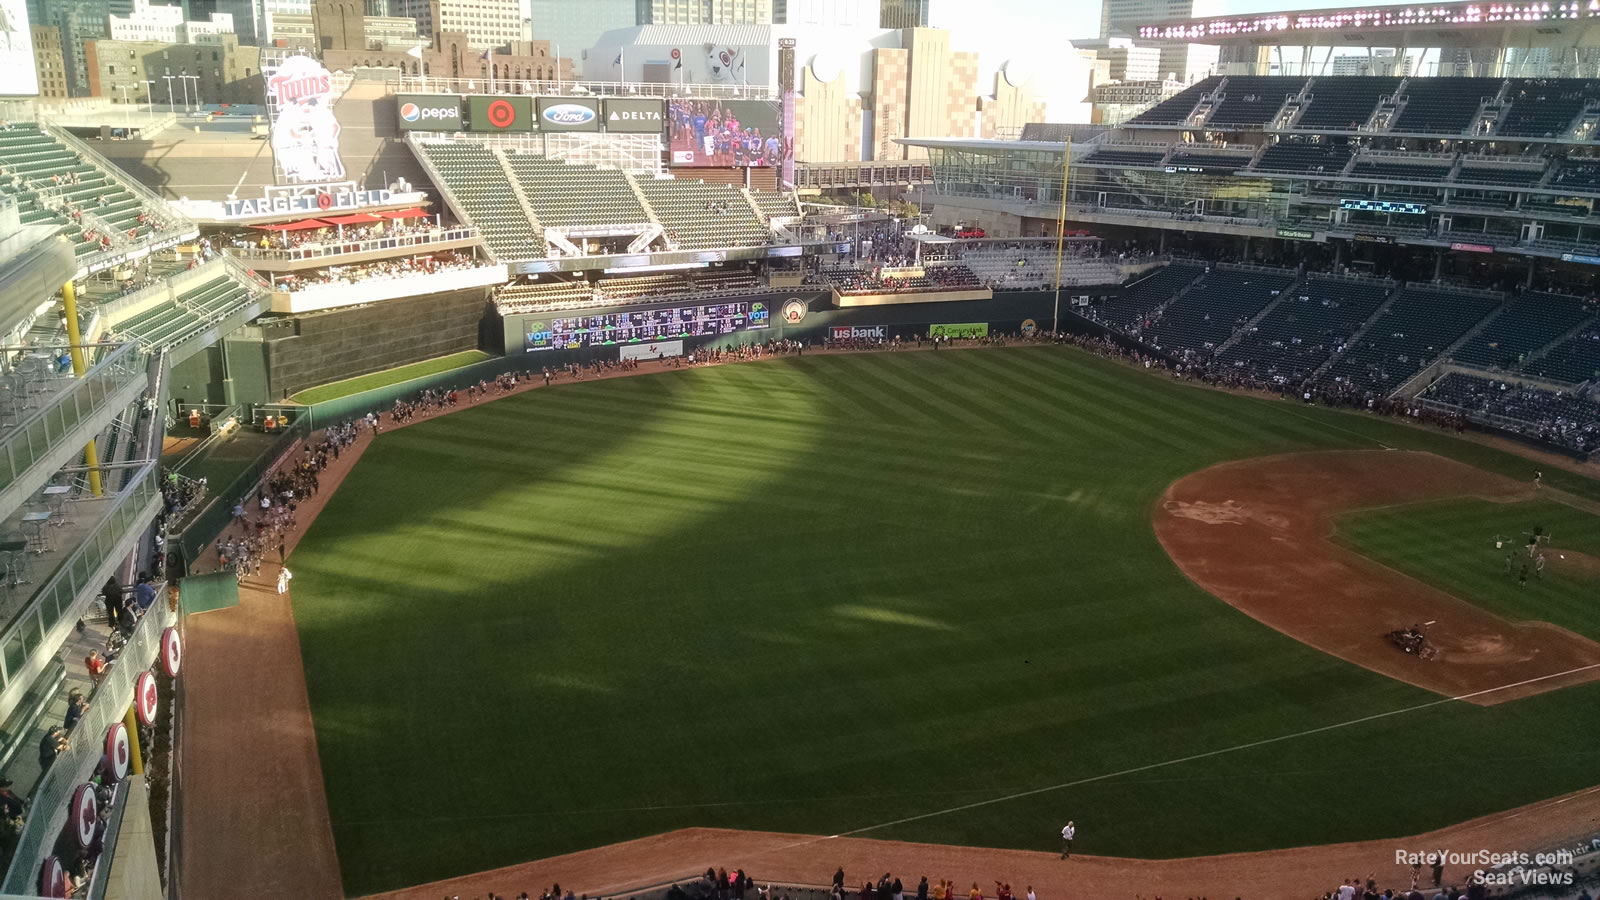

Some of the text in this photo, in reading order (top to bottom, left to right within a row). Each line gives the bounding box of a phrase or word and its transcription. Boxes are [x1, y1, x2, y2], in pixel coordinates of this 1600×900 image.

[270, 73, 330, 106] Twins
[421, 105, 459, 120] pepsi
[553, 107, 585, 121] Ford
[622, 111, 661, 120] DELTA
[225, 189, 393, 217] TARGET FIELD
[748, 311, 769, 319] VOTE
[527, 331, 552, 342] VOTE
